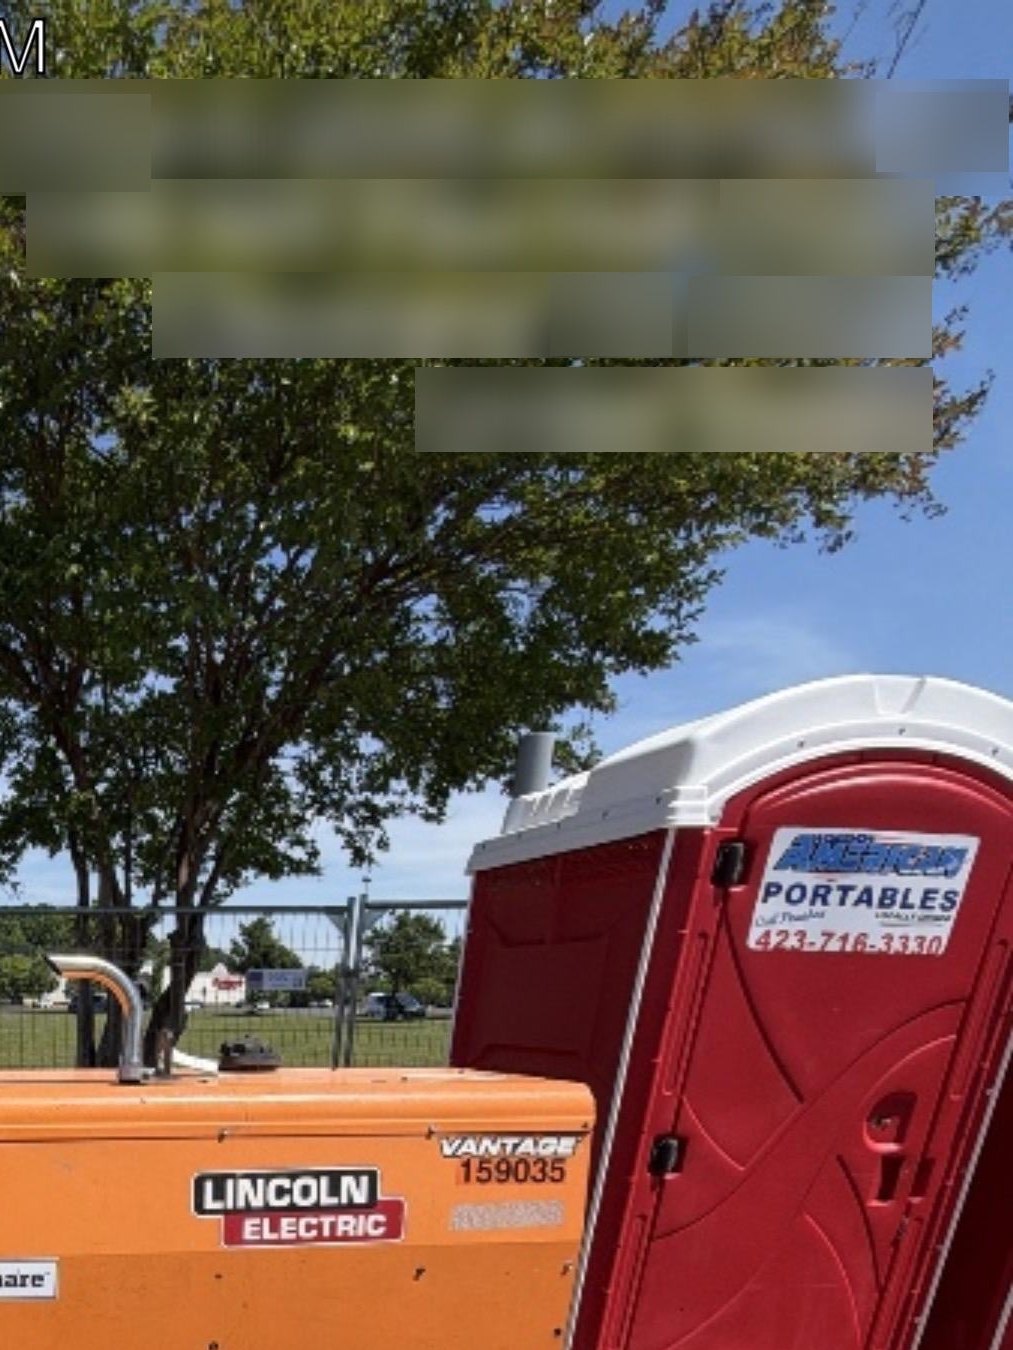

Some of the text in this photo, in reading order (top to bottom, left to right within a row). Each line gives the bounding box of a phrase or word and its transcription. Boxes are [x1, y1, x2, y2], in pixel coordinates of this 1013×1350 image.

[761, 881, 960, 912] PORTABLES
[755, 929, 943, 954] 423-716-3330
[441, 1136, 577, 1158] VANTAGE
[461, 1158, 566, 1183] 159035
[202, 1175, 370, 1211] LINCOLN
[242, 1213, 388, 1241] ELECTRIC
